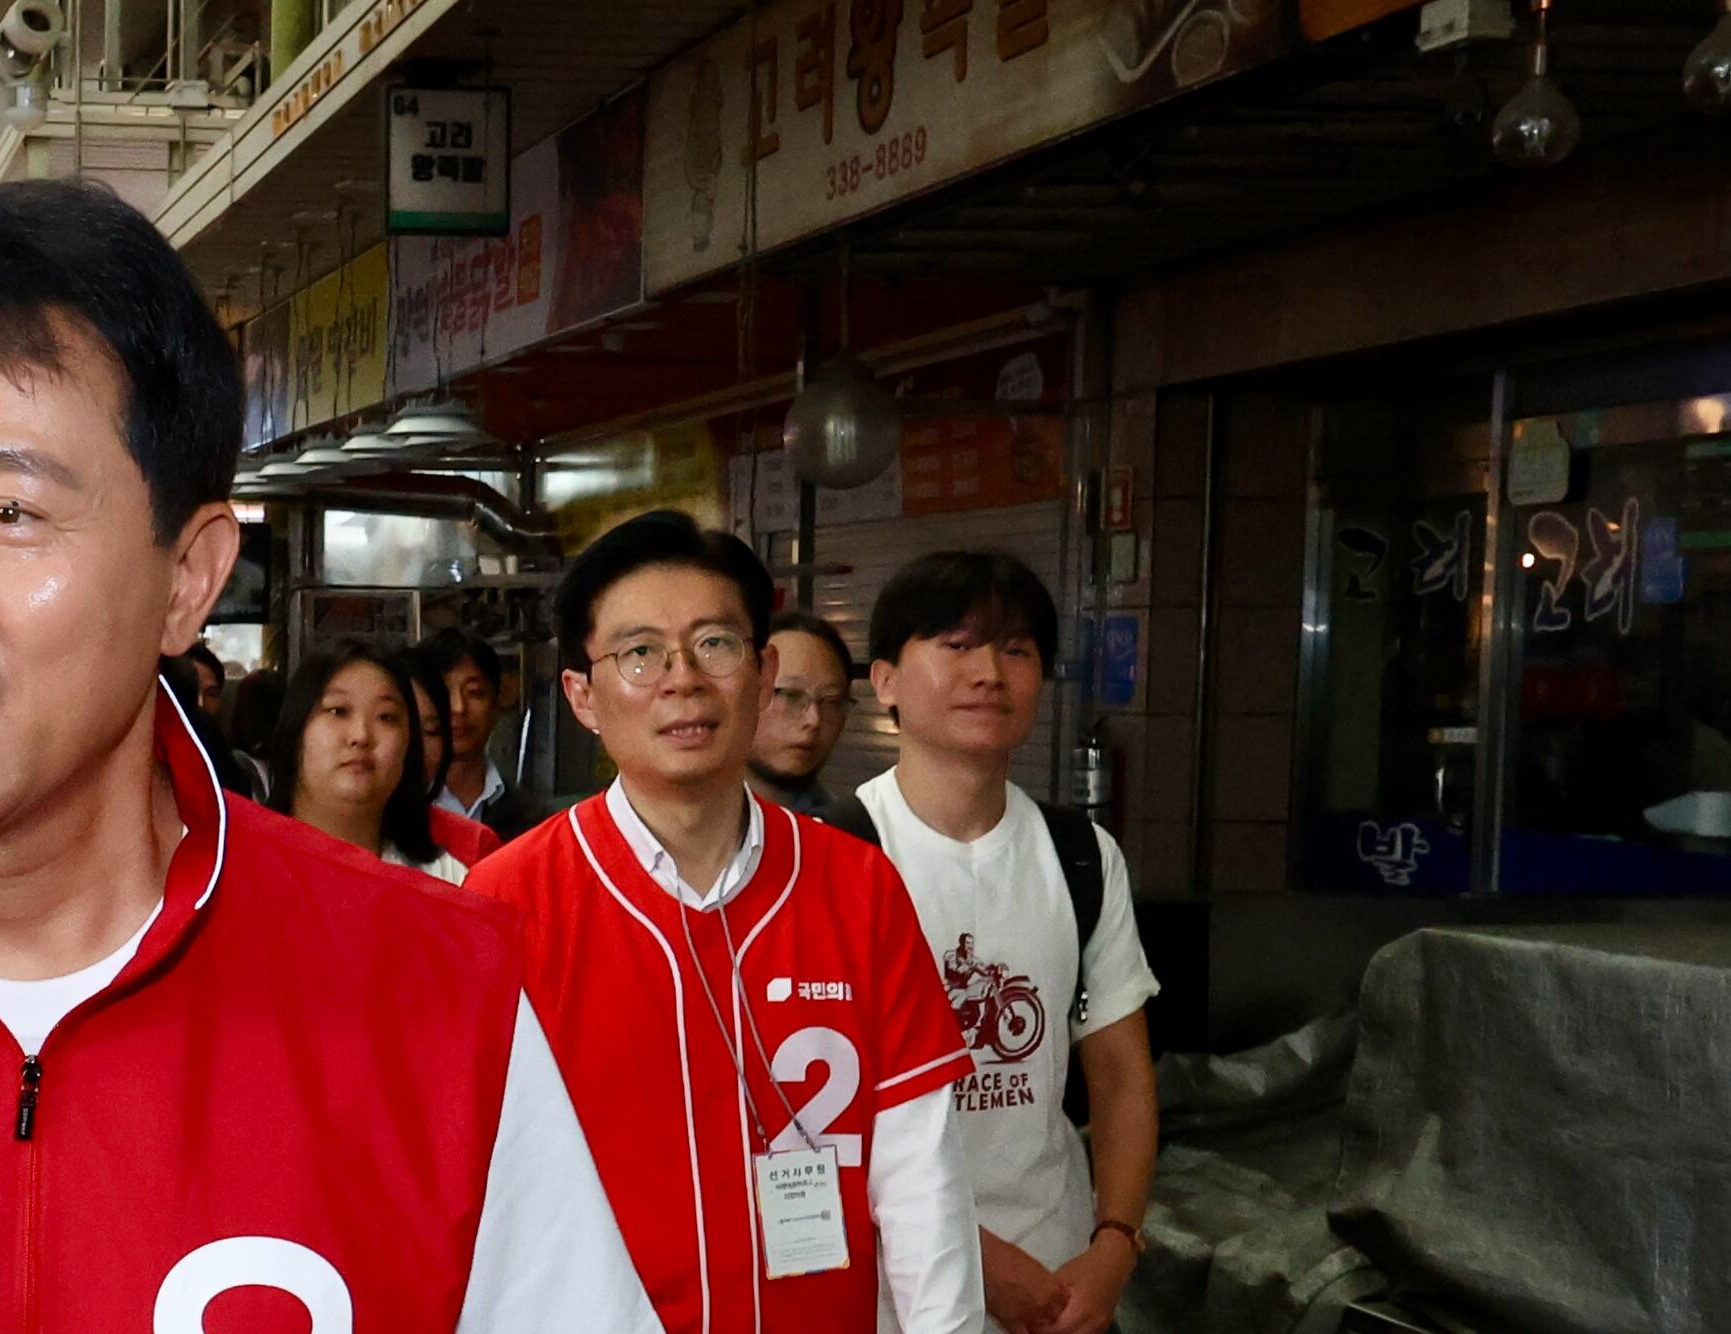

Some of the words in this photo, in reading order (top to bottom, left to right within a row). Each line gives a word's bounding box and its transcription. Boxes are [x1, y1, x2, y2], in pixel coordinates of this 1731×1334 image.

[392, 95, 419, 116] 64
[951, 1072, 1002, 1093] RACE
[1009, 1073, 1029, 1088] OF
[769, 1026, 863, 1168] 2
